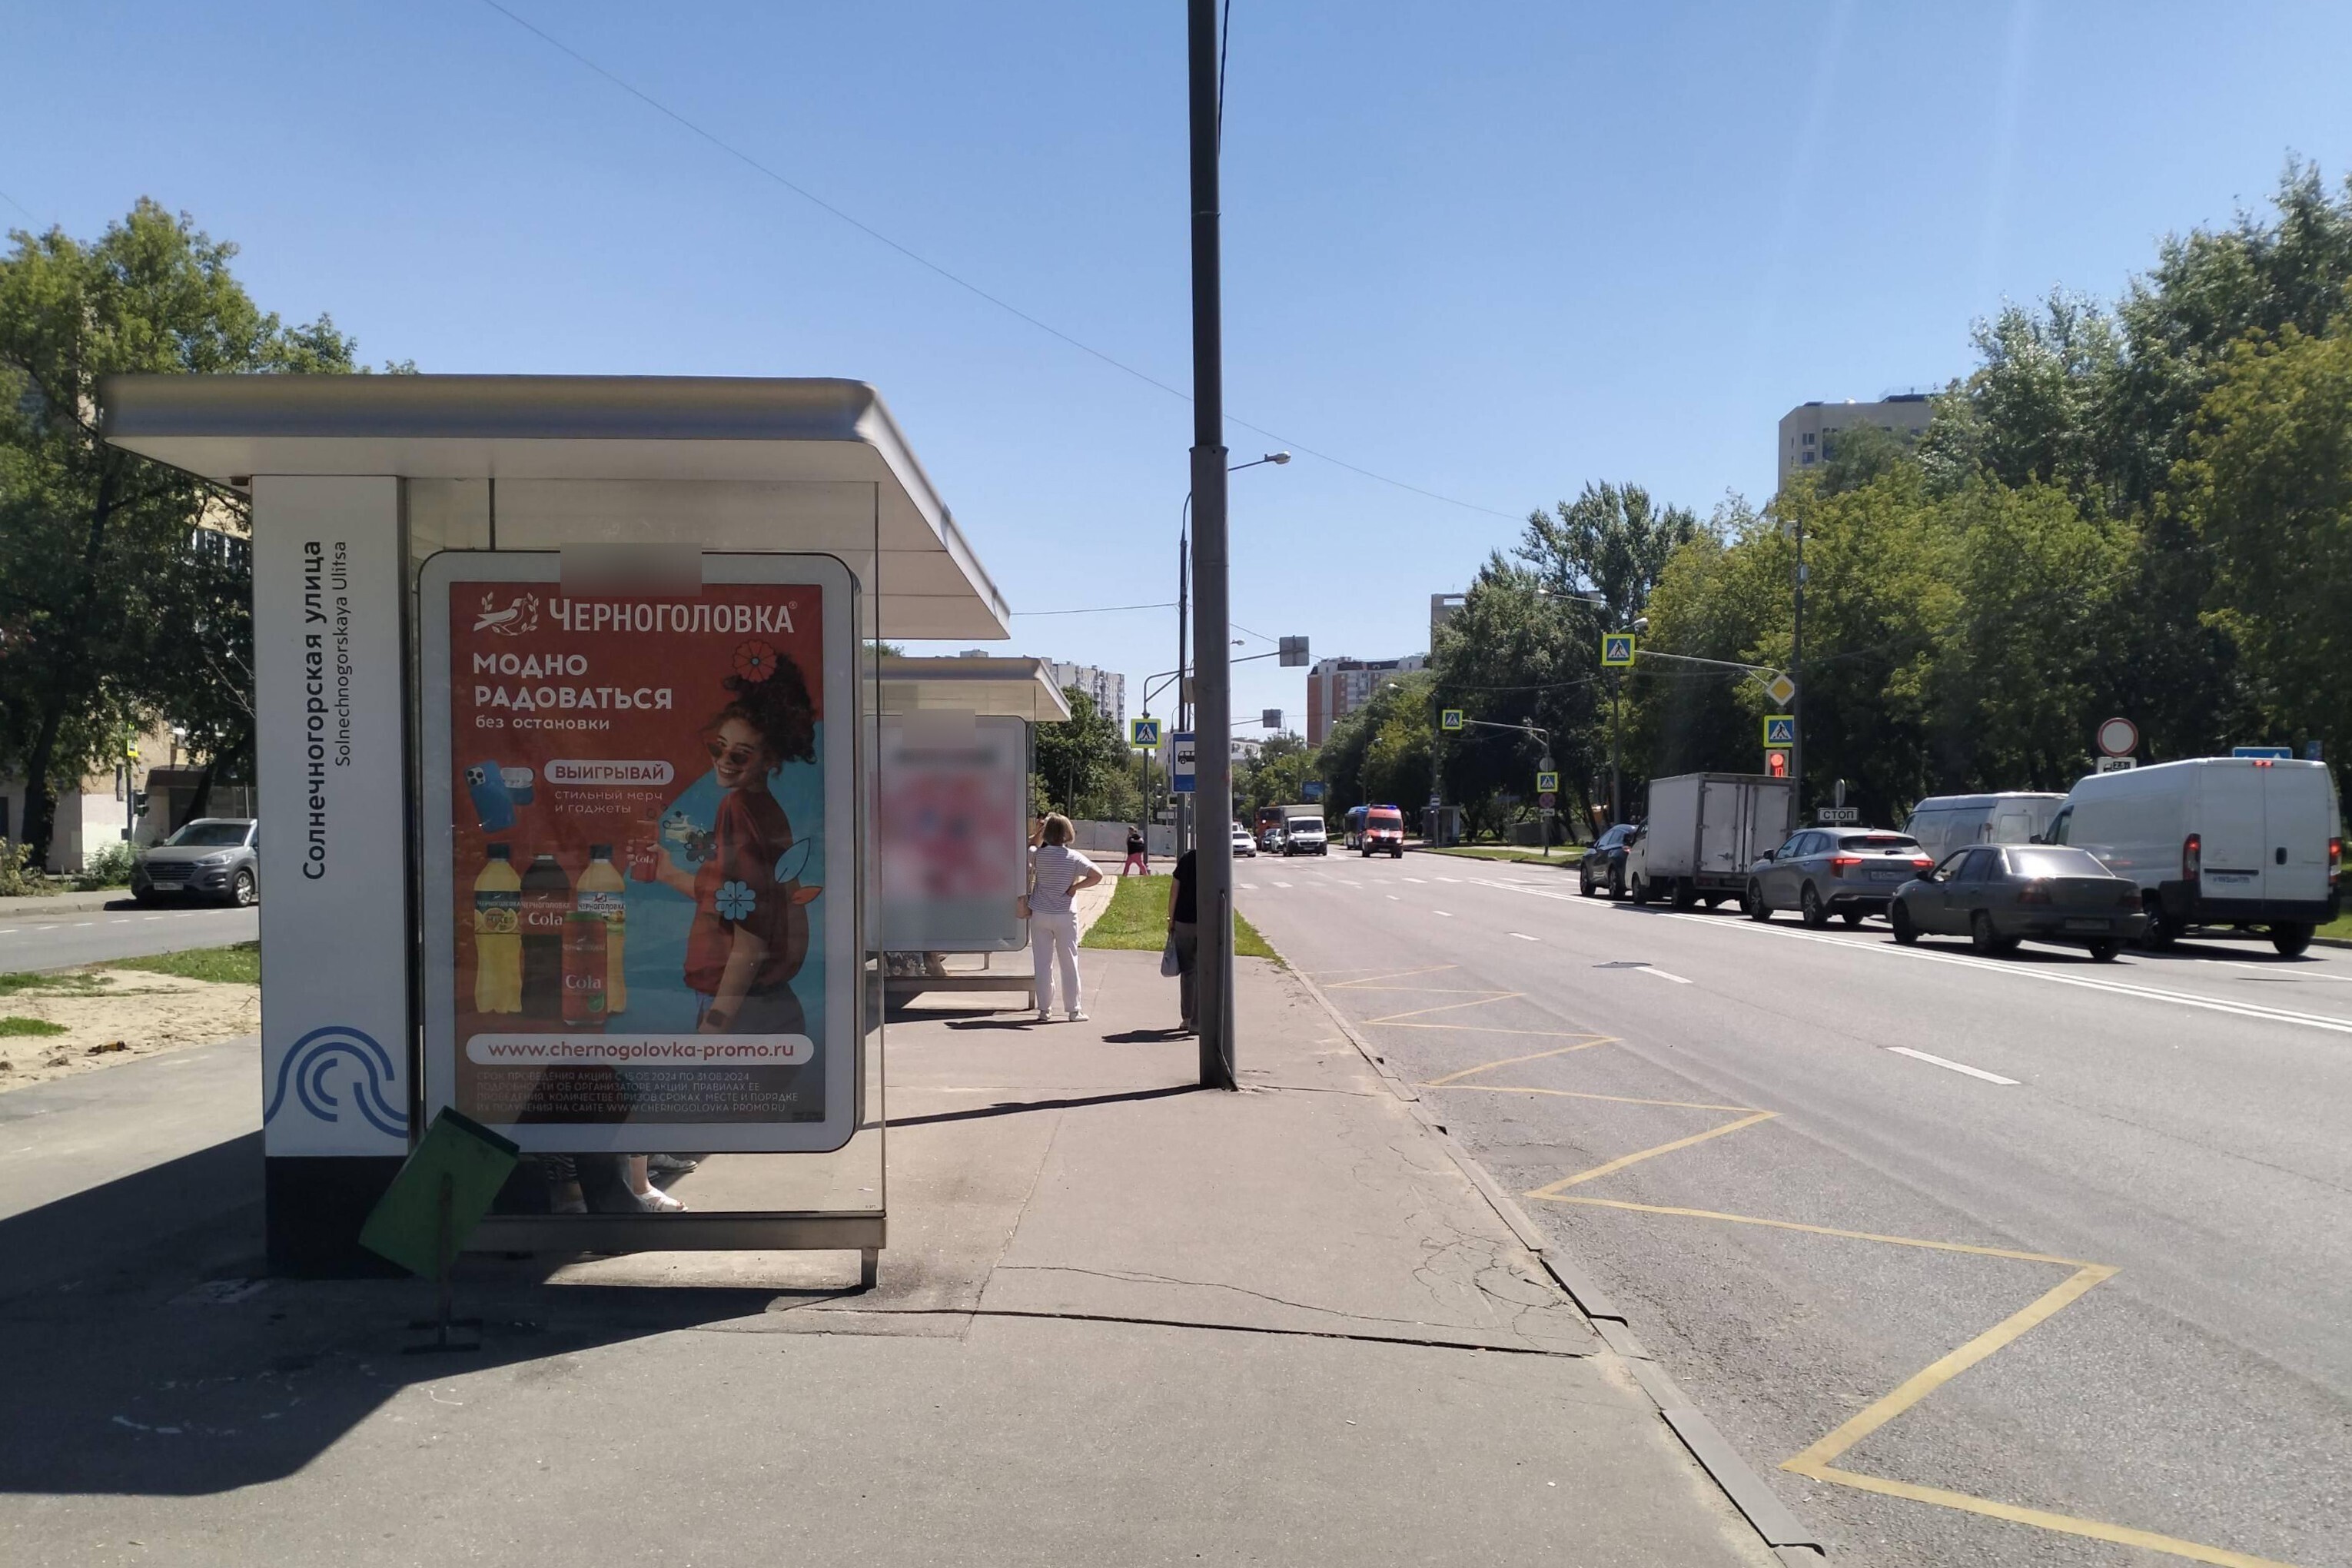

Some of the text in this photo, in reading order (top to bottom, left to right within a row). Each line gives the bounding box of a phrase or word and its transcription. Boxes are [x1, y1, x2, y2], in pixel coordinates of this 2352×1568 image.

[331, 541, 352, 766] Solnechnogorskaya Ulitsa
[473, 653, 588, 679] МОДНО
[474, 686, 673, 711] РАДОВАТЬСЯ
[303, 541, 329, 879] Солнечногорская улица
[476, 715, 610, 730] без остановки
[555, 763, 664, 780] ВЫИГРЫВАЙ
[555, 790, 663, 802] стильный мерч
[555, 804, 631, 814] и гаджеты
[1823, 810, 1854, 819] СТОП
[528, 912, 563, 926] Cola
[565, 974, 601, 989] Cola
[487, 1041, 795, 1061] www.chernogolovka-promo.ru
[578, 1072, 612, 1081] АКЦИИ
[679, 1072, 694, 1081] ПО
[556, 1082, 571, 1091] ОБ
[573, 1082, 651, 1091] ОРГАНИЗАТОРЕ
[693, 1082, 746, 1091] ПРАВИЛАХ
[748, 1082, 760, 1091] ЕЕ
[549, 1092, 614, 1102] КОЛИЧЕСТВЕ
[706, 1093, 738, 1102] МЕСТЕ
[740, 1093, 748, 1102] И
[750, 1092, 799, 1102] ПОРЯДКЕ
[555, 1103, 569, 1112] НА
[572, 1102, 604, 1112] САЙТЕ
